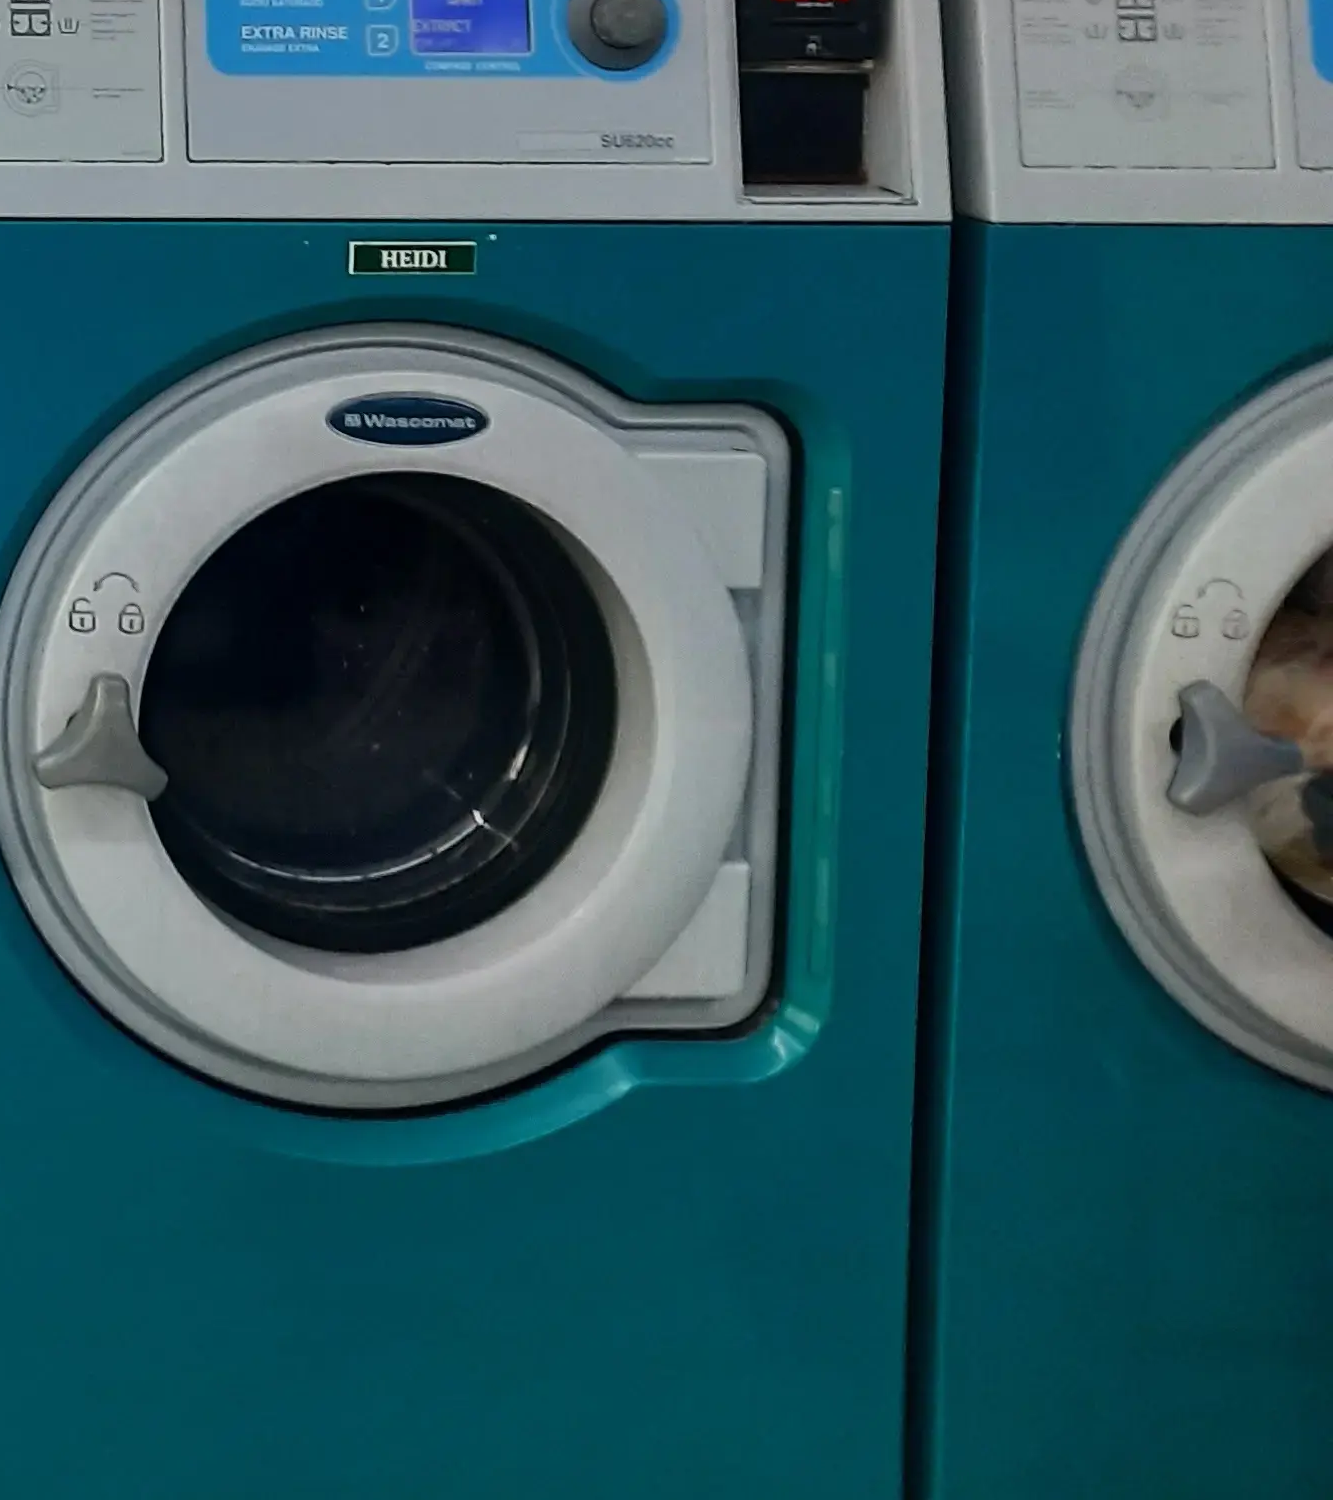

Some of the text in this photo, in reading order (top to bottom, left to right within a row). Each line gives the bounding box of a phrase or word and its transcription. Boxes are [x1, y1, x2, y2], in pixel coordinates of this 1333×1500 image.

[241, 26, 349, 40] EXTRA RINSE
[377, 32, 389, 49] 2
[380, 249, 448, 268] HEIDI
[363, 413, 476, 429] Wascomat
